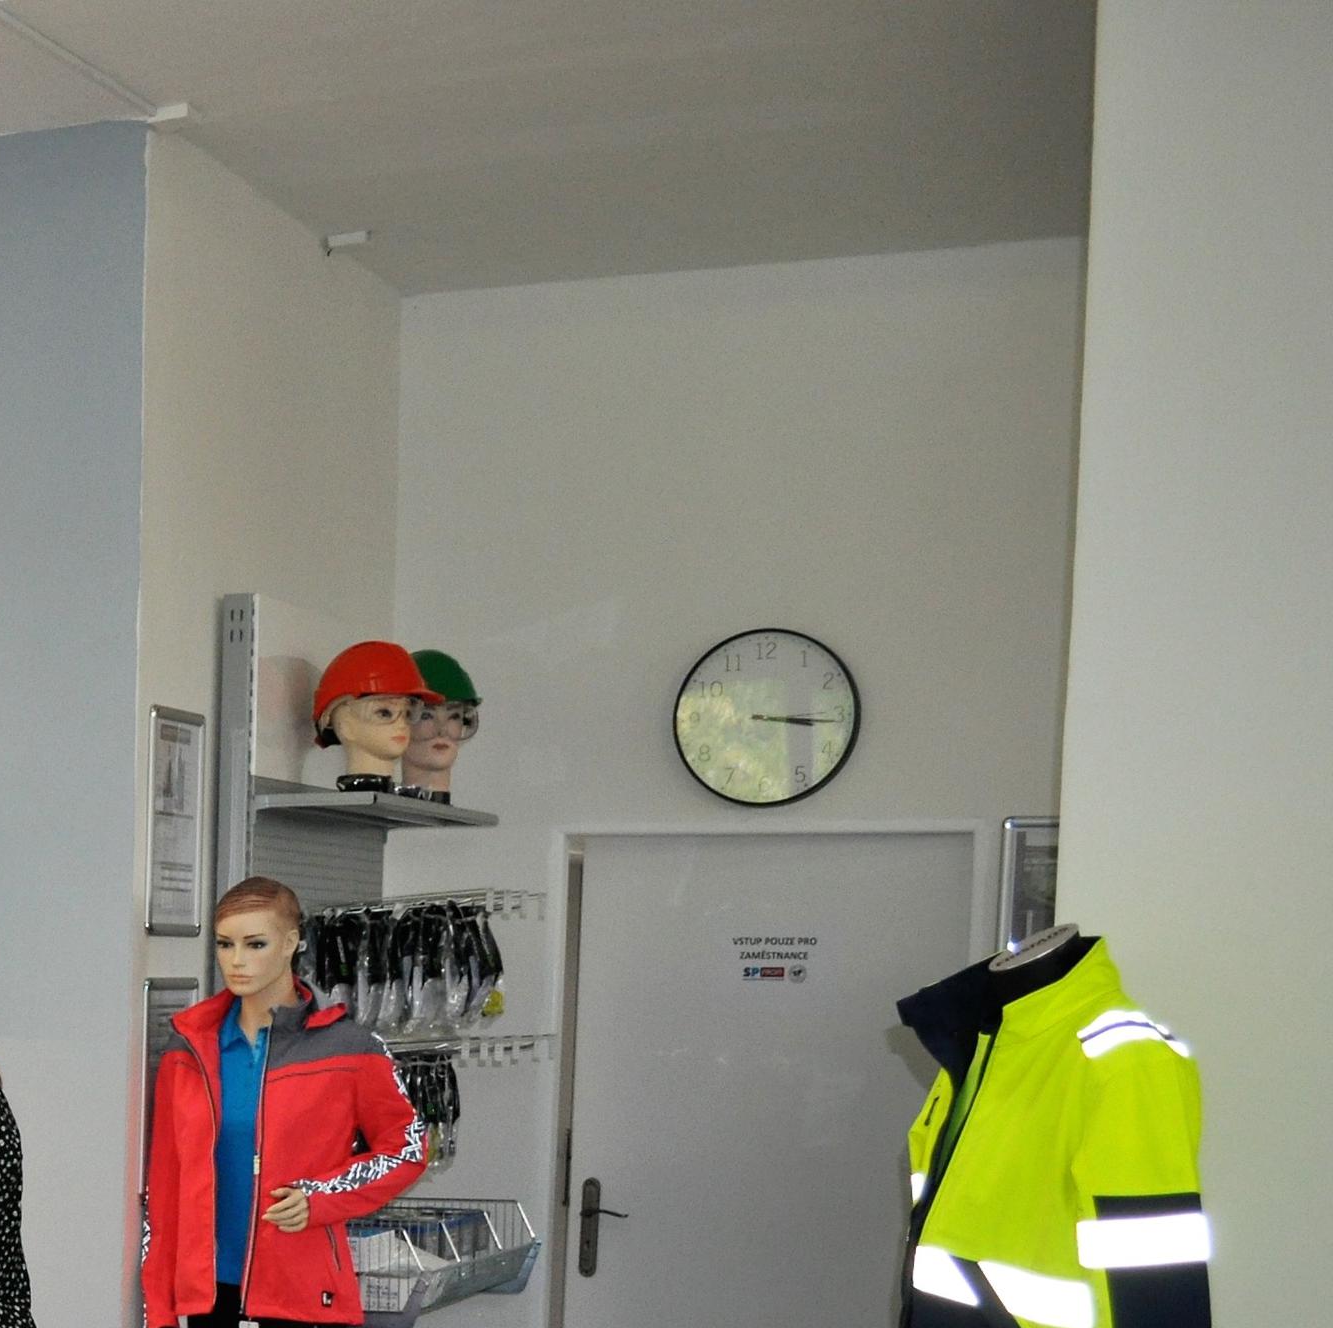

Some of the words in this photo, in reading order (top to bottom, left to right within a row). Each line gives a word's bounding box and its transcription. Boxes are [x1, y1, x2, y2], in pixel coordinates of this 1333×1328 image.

[756, 643, 777, 660] 12
[801, 650, 808, 668] 1
[724, 654, 742, 672] 11
[700, 681, 724, 698] 10
[822, 672, 835, 690] 2
[794, 765, 807, 784] 5
[732, 937, 763, 946] VSTUP
[764, 937, 795, 946] POUZE
[797, 937, 818, 946] PRO
[742, 967, 760, 977] SP
